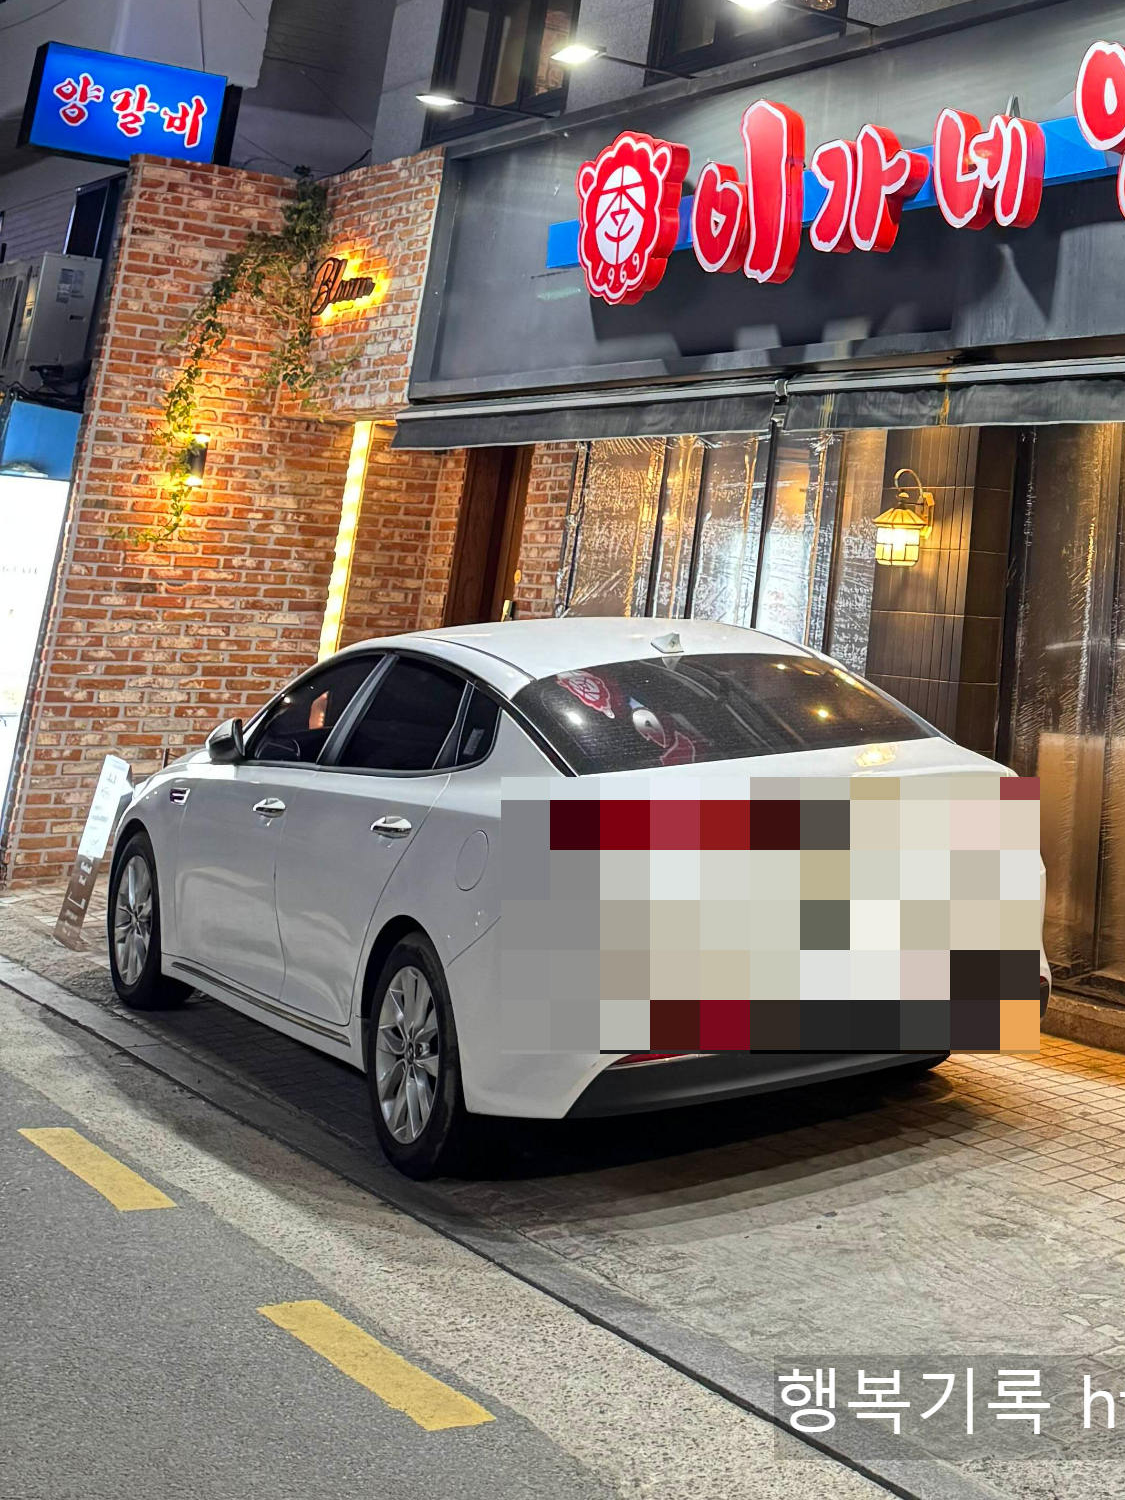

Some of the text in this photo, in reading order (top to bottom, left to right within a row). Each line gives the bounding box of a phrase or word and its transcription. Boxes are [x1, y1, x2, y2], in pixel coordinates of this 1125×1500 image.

[53, 73, 208, 148] 양갈비
[692, 99, 1044, 283] 이가네
[595, 252, 640, 288] 1969
